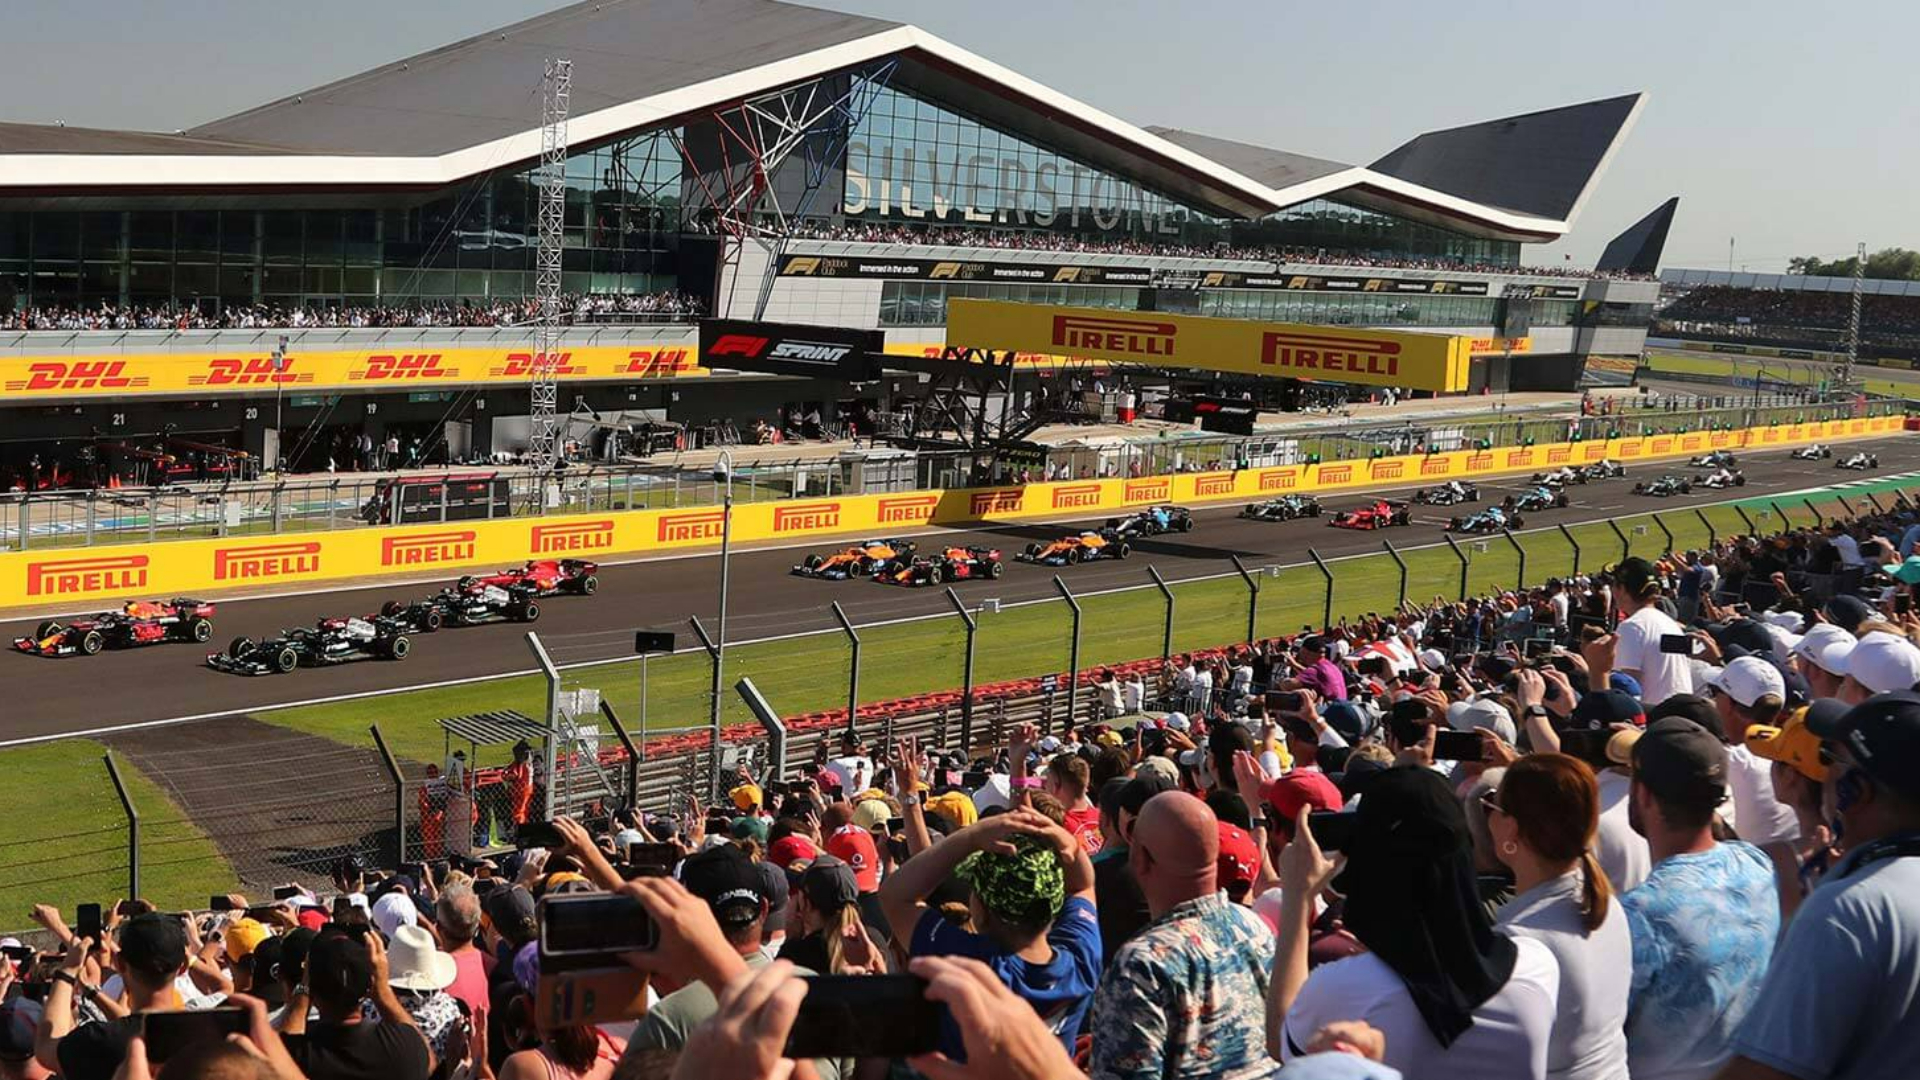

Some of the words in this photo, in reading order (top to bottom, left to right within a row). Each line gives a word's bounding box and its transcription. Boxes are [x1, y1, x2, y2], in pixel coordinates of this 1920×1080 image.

[844, 141, 1180, 235] SILVERSTONE
[708, 334, 769, 357] F1
[770, 343, 851, 361] SPRINT
[1052, 315, 1178, 356] PIRELLI
[364, 355, 446, 379] DHL
[503, 353, 574, 376] DHL
[626, 351, 690, 374] DHL
[1261, 332, 1401, 376] PIRELLI
[26, 361, 131, 390] DHL
[206, 359, 298, 385] DHL
[113, 413, 125, 426] 21
[246, 407, 258, 420] 20
[1259, 469, 1296, 491] PIRELLI
[1318, 465, 1352, 485] PIRELLI
[1372, 461, 1403, 480] PIRELLI
[1052, 485, 1101, 508] PIRELLI
[1125, 480, 1169, 502] PIRELLI
[1195, 473, 1235, 496] PIRELLI
[878, 496, 937, 523] PIRELLI
[969, 488, 1023, 515] PIRELLI
[658, 511, 731, 541] PIRELL
[774, 503, 840, 532] PIRELLI
[381, 531, 476, 566] PIRELLI
[531, 521, 614, 553] PIRELLI
[214, 542, 321, 580] PIRELLI
[27, 555, 149, 596] PIRELLI
